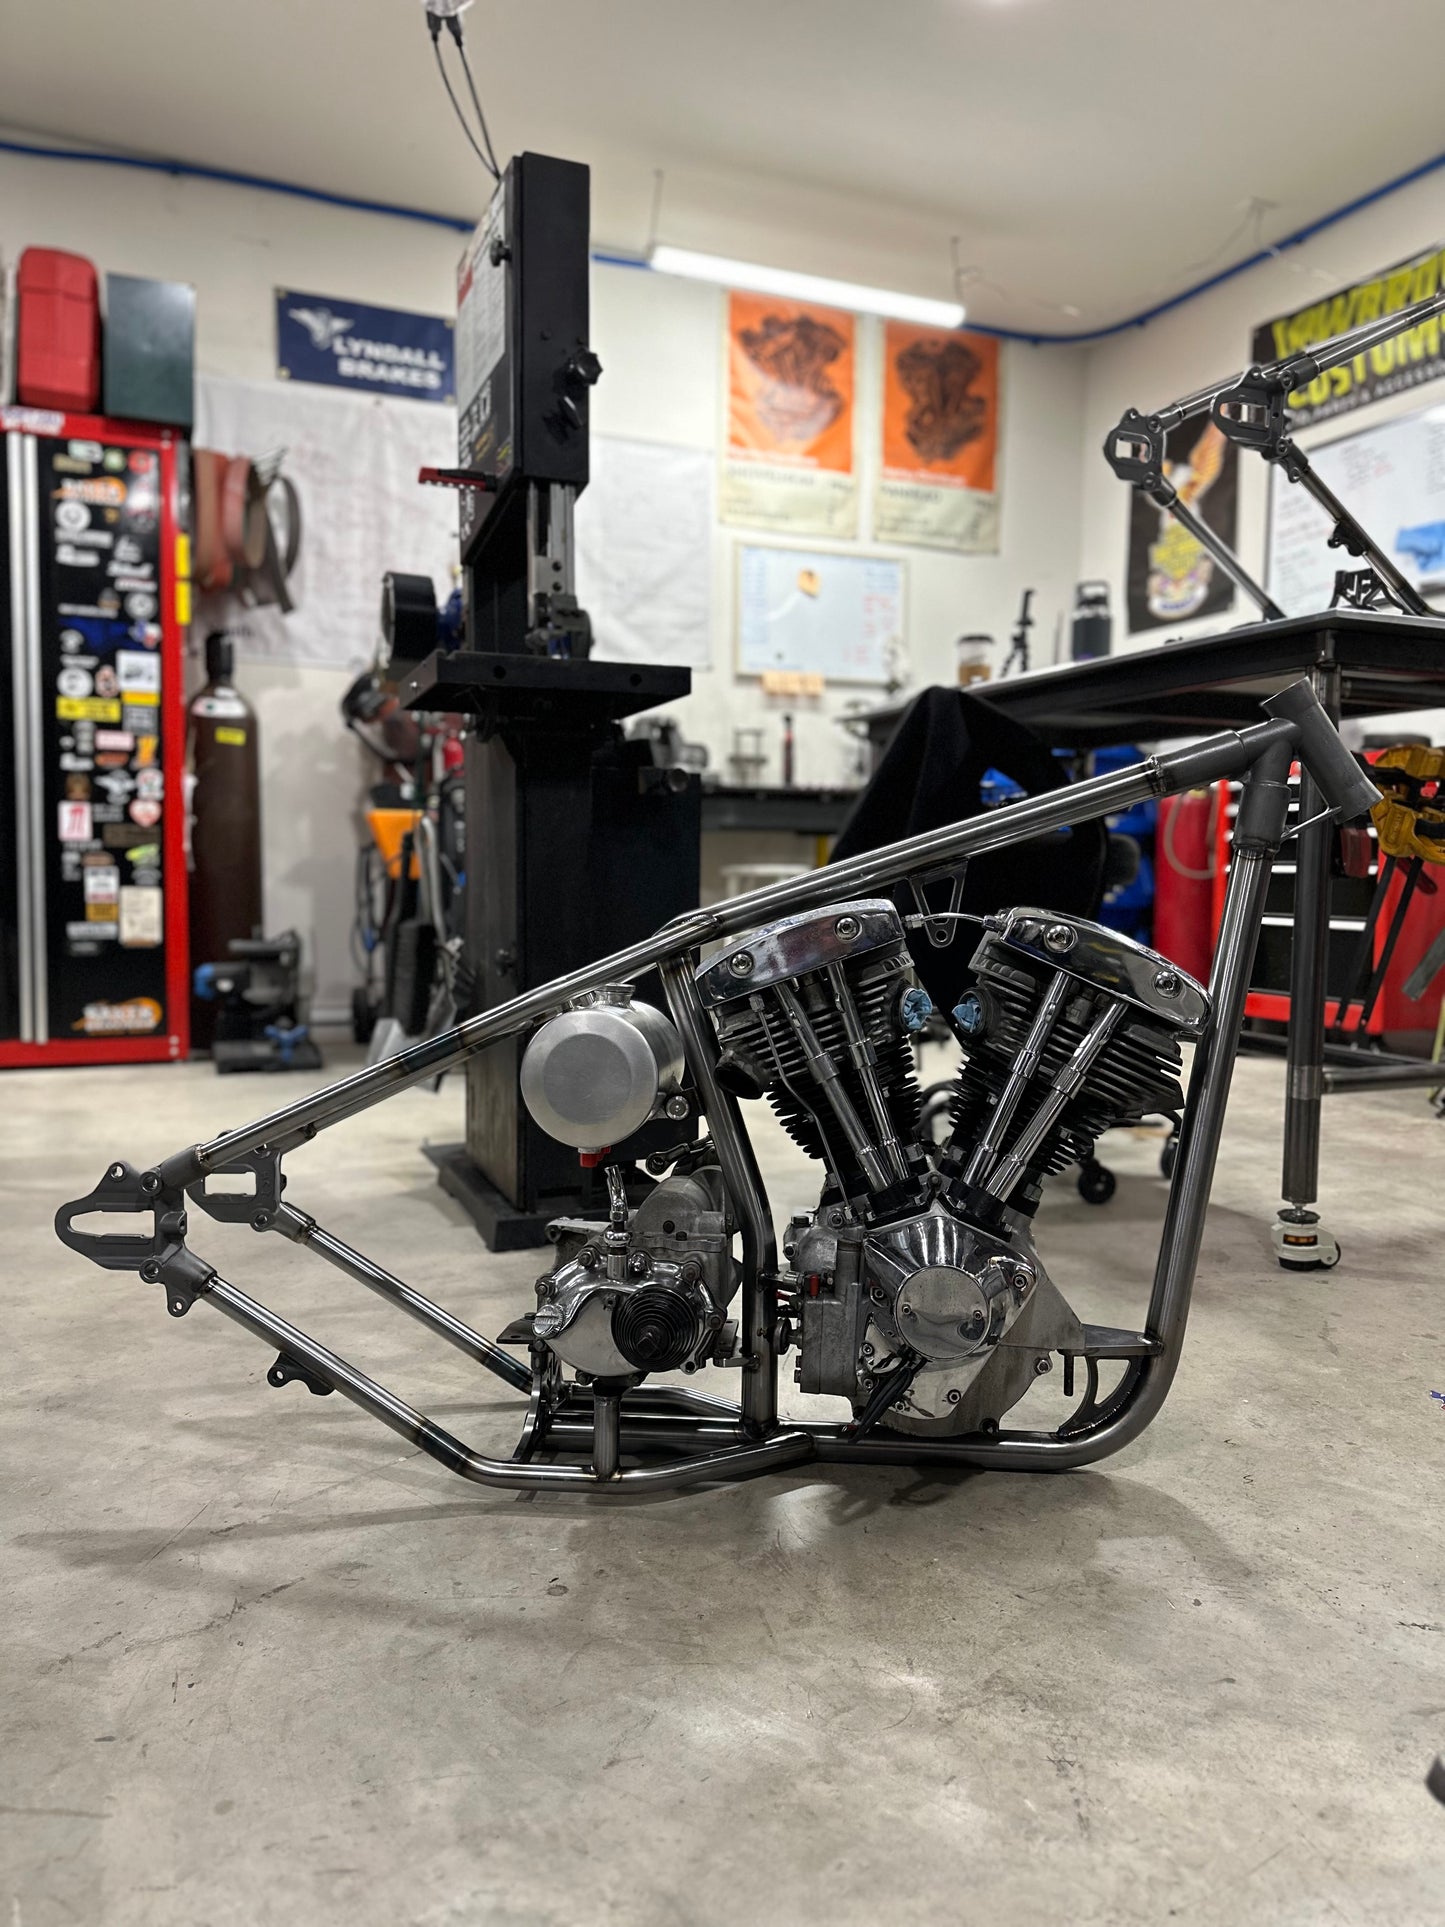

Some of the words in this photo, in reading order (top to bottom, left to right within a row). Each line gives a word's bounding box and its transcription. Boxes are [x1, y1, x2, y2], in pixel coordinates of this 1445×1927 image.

[1272, 248, 1445, 360] LOWBRO
[332, 335, 446, 371] LYNDALL
[337, 356, 441, 389] BRAKES
[1288, 311, 1445, 409] USTOM
